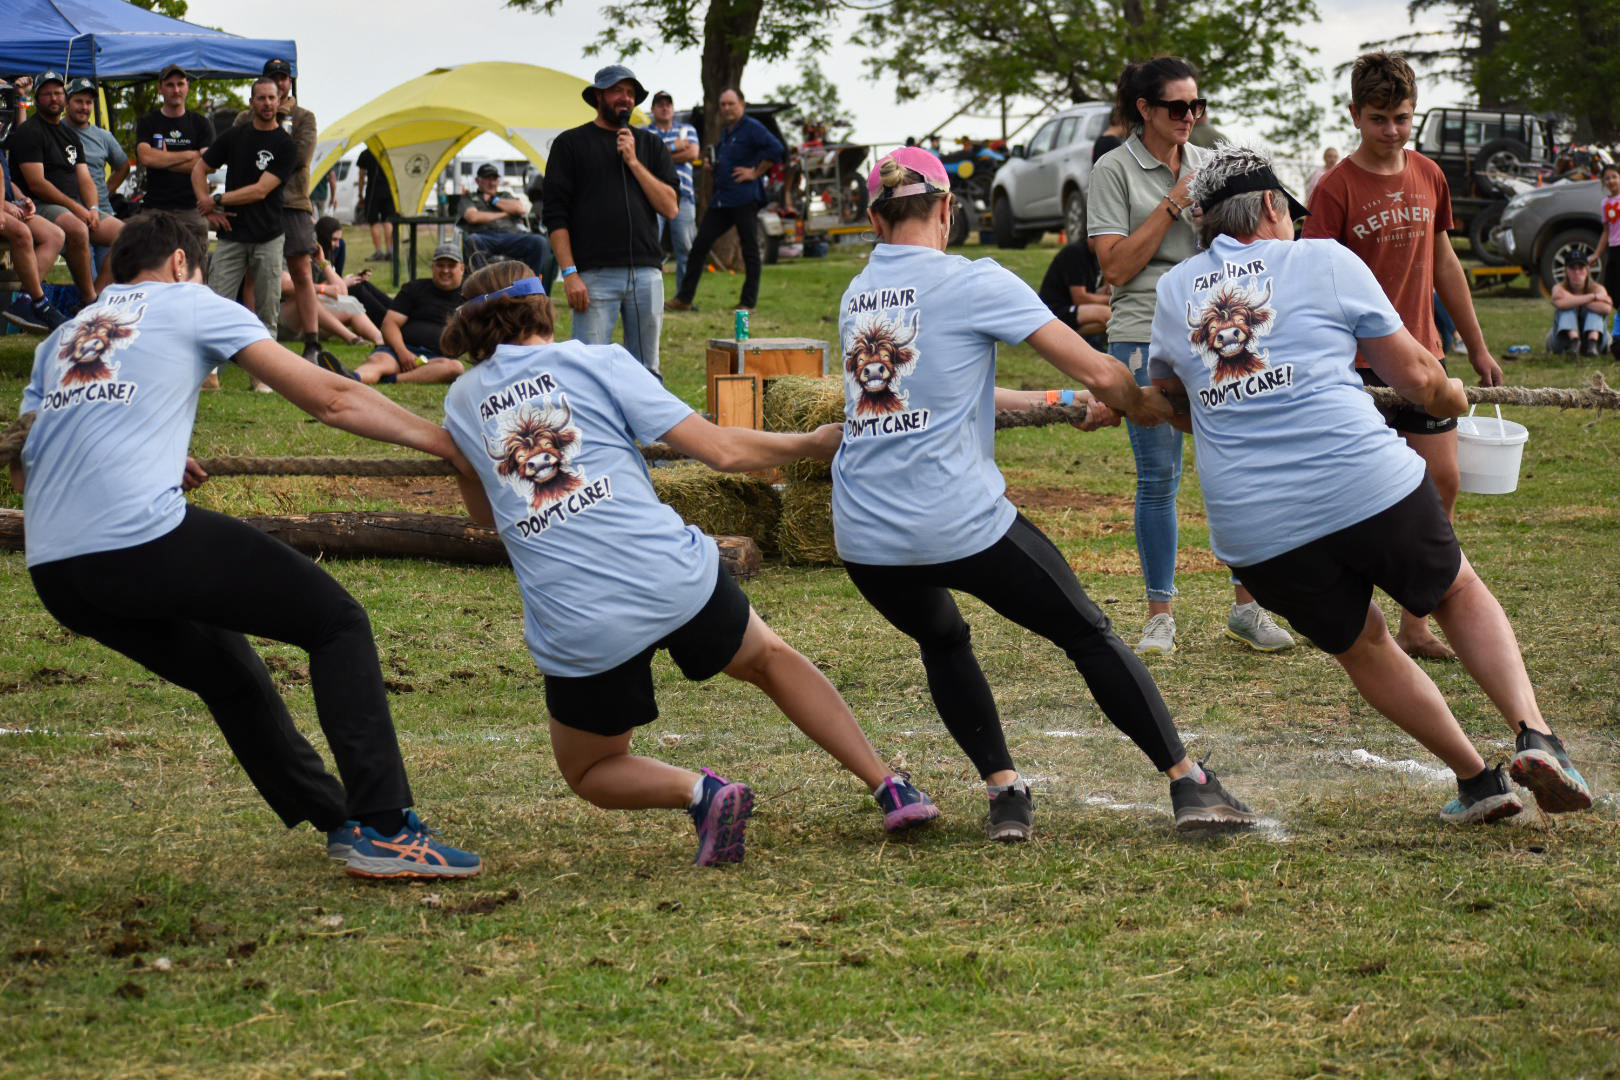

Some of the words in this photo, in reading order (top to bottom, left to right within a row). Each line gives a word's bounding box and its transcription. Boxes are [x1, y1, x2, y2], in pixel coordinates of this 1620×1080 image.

[1226, 260, 1265, 279] HAIR
[108, 292, 144, 306] HAIR
[848, 292, 878, 315] FARM
[881, 289, 915, 309] HAIR
[44, 387, 85, 409] DON'T
[86, 383, 135, 404] CARE!
[480, 391, 515, 422] FARM
[515, 374, 556, 402] HAIR
[1200, 381, 1242, 407] DON'T
[1246, 366, 1292, 396] CARE!
[883, 411, 929, 434] CARE!
[516, 502, 565, 538] DON'T
[568, 478, 611, 514] CARE!
